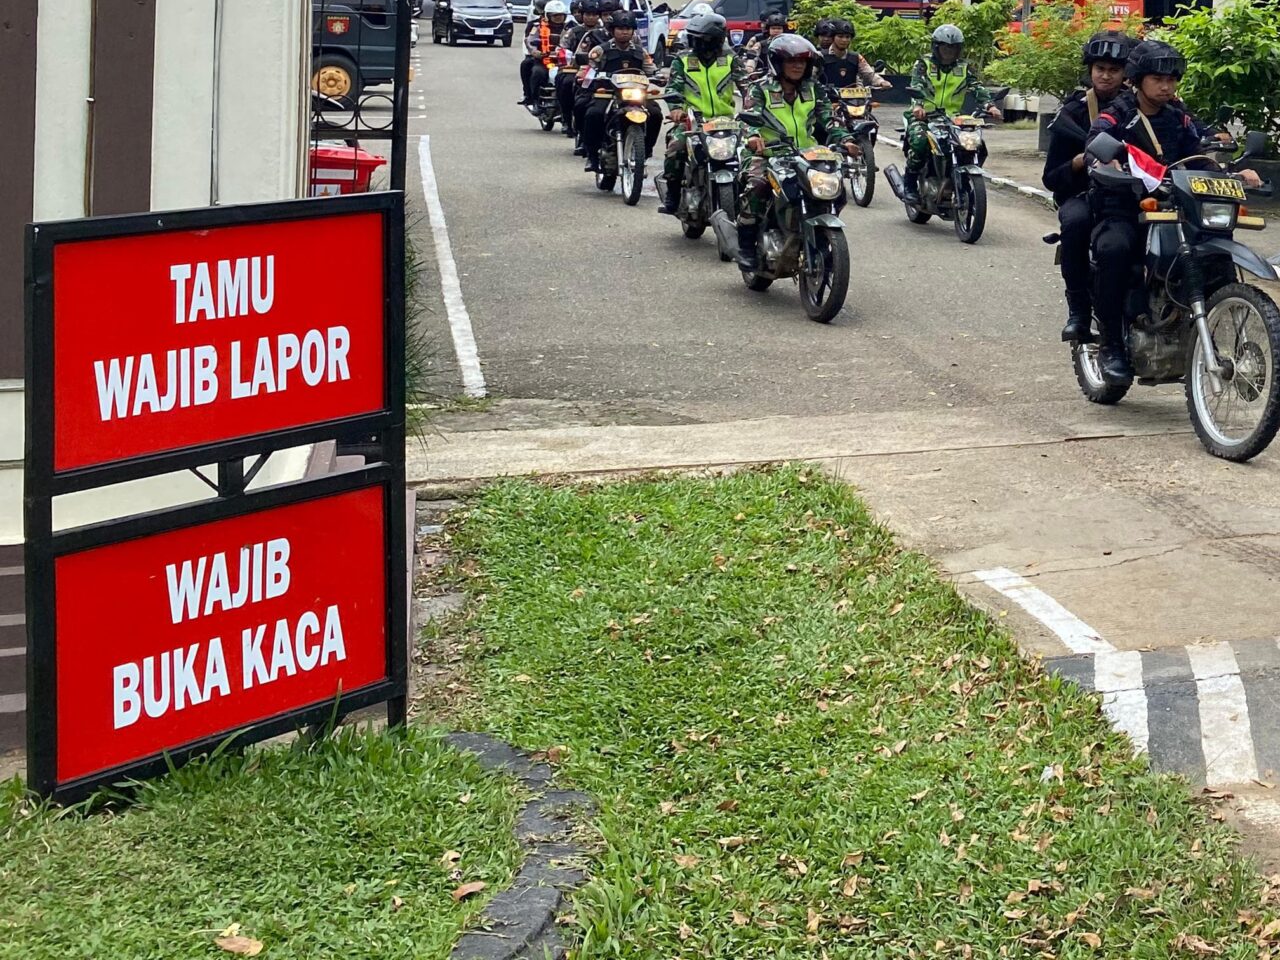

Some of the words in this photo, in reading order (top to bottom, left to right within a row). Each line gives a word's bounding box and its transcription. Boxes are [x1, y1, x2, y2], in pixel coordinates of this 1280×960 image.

[170, 254, 275, 324] TAMU
[93, 344, 219, 422] WAJIB
[230, 325, 351, 400] LAPOR
[165, 537, 291, 625] WAJIB
[113, 636, 231, 730] BUKA
[241, 604, 347, 690] KACA
